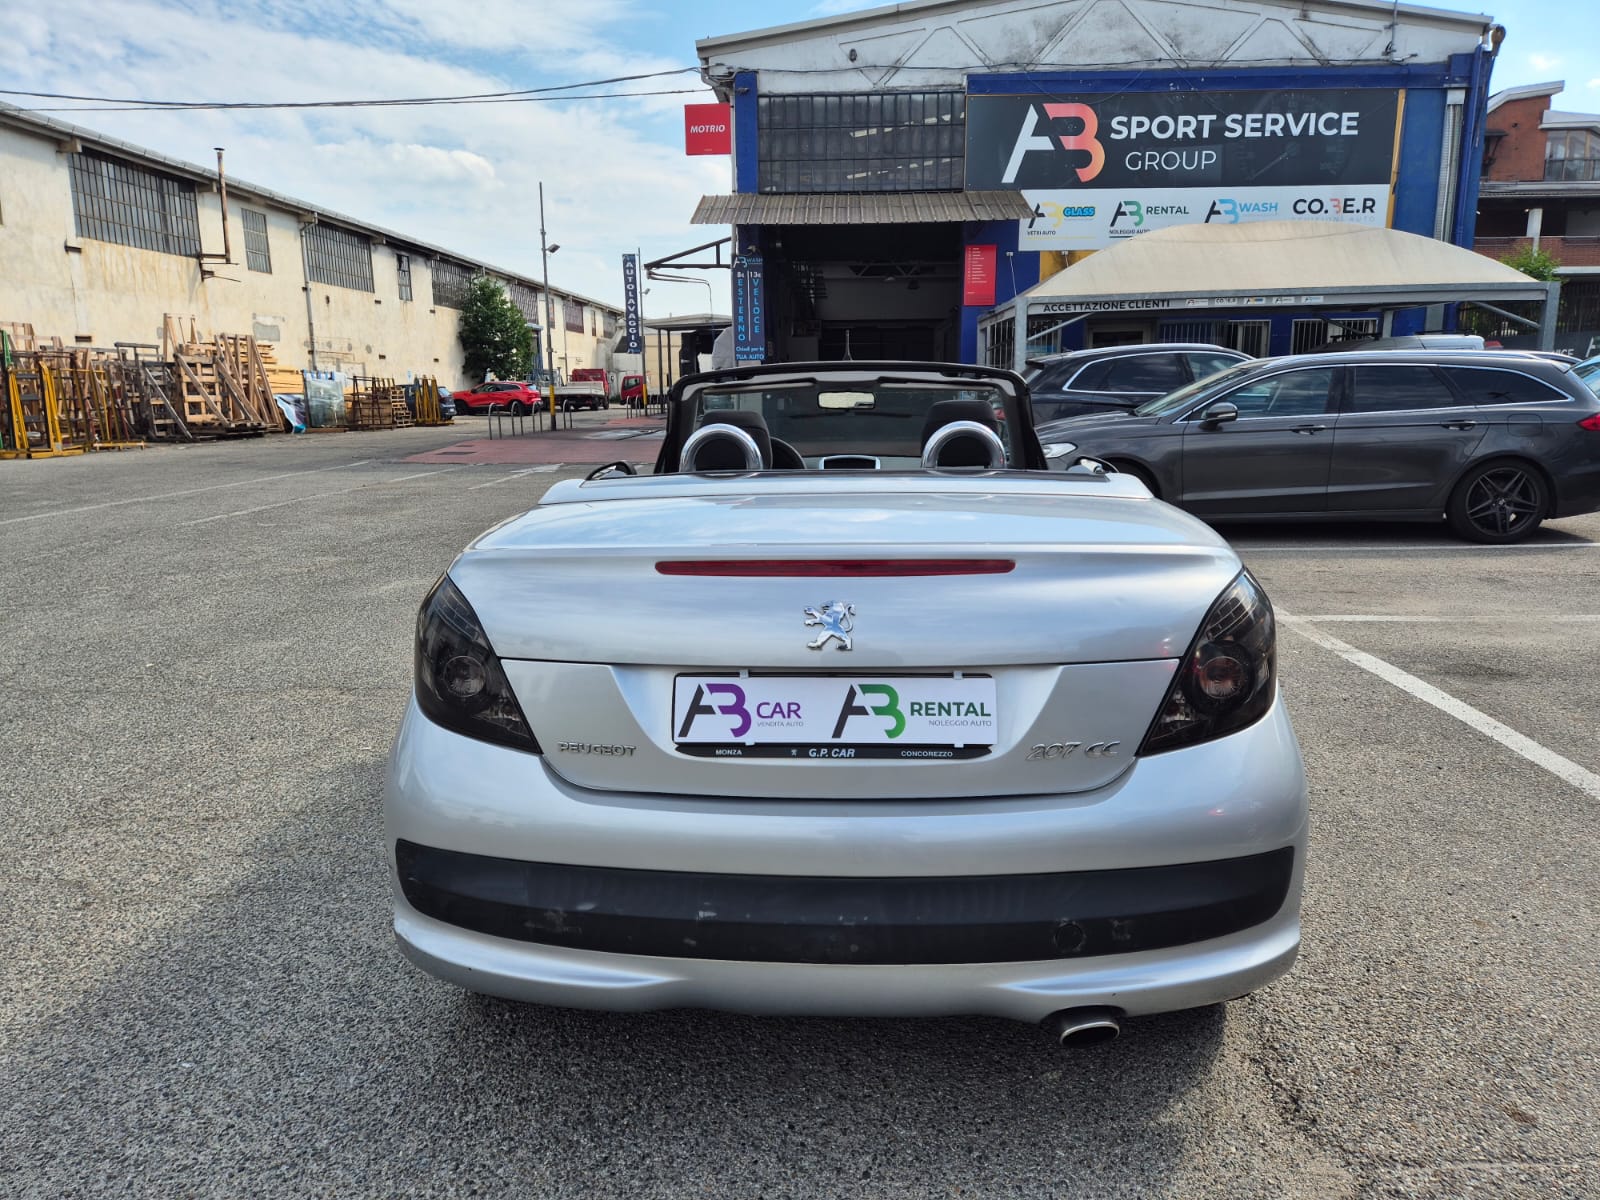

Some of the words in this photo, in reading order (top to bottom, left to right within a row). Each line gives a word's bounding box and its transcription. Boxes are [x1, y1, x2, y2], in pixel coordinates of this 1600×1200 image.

[690, 124, 726, 134] MOTRIO
[1110, 114, 1217, 140] SPORT
[1224, 111, 1360, 138] SERVICE
[1125, 150, 1217, 171] GROUP
[1063, 206, 1096, 217] GLASS
[1146, 205, 1190, 216] RENTAL
[1239, 202, 1279, 213] WASH
[625, 261, 638, 348] AUTOLAVAGGIO
[737, 278, 746, 342] ESTERNO
[752, 278, 761, 334] VELOCE
[1043, 301, 1126, 313] ACCETTAZIONE
[1127, 299, 1170, 309] CLIENTI
[756, 701, 802, 719] CAR
[909, 702, 992, 717] RENTAL
[756, 720, 783, 728] VENDITA
[928, 719, 968, 727] NOLEGGIO
[970, 719, 992, 727] AUTO
[557, 741, 636, 757] PEUGEOT
[808, 748, 829, 758] G.P.
[831, 748, 855, 758] CAR
[900, 750, 954, 758] CONCOREZZO
[1025, 741, 1082, 762] 207
[1084, 740, 1121, 758] CC
